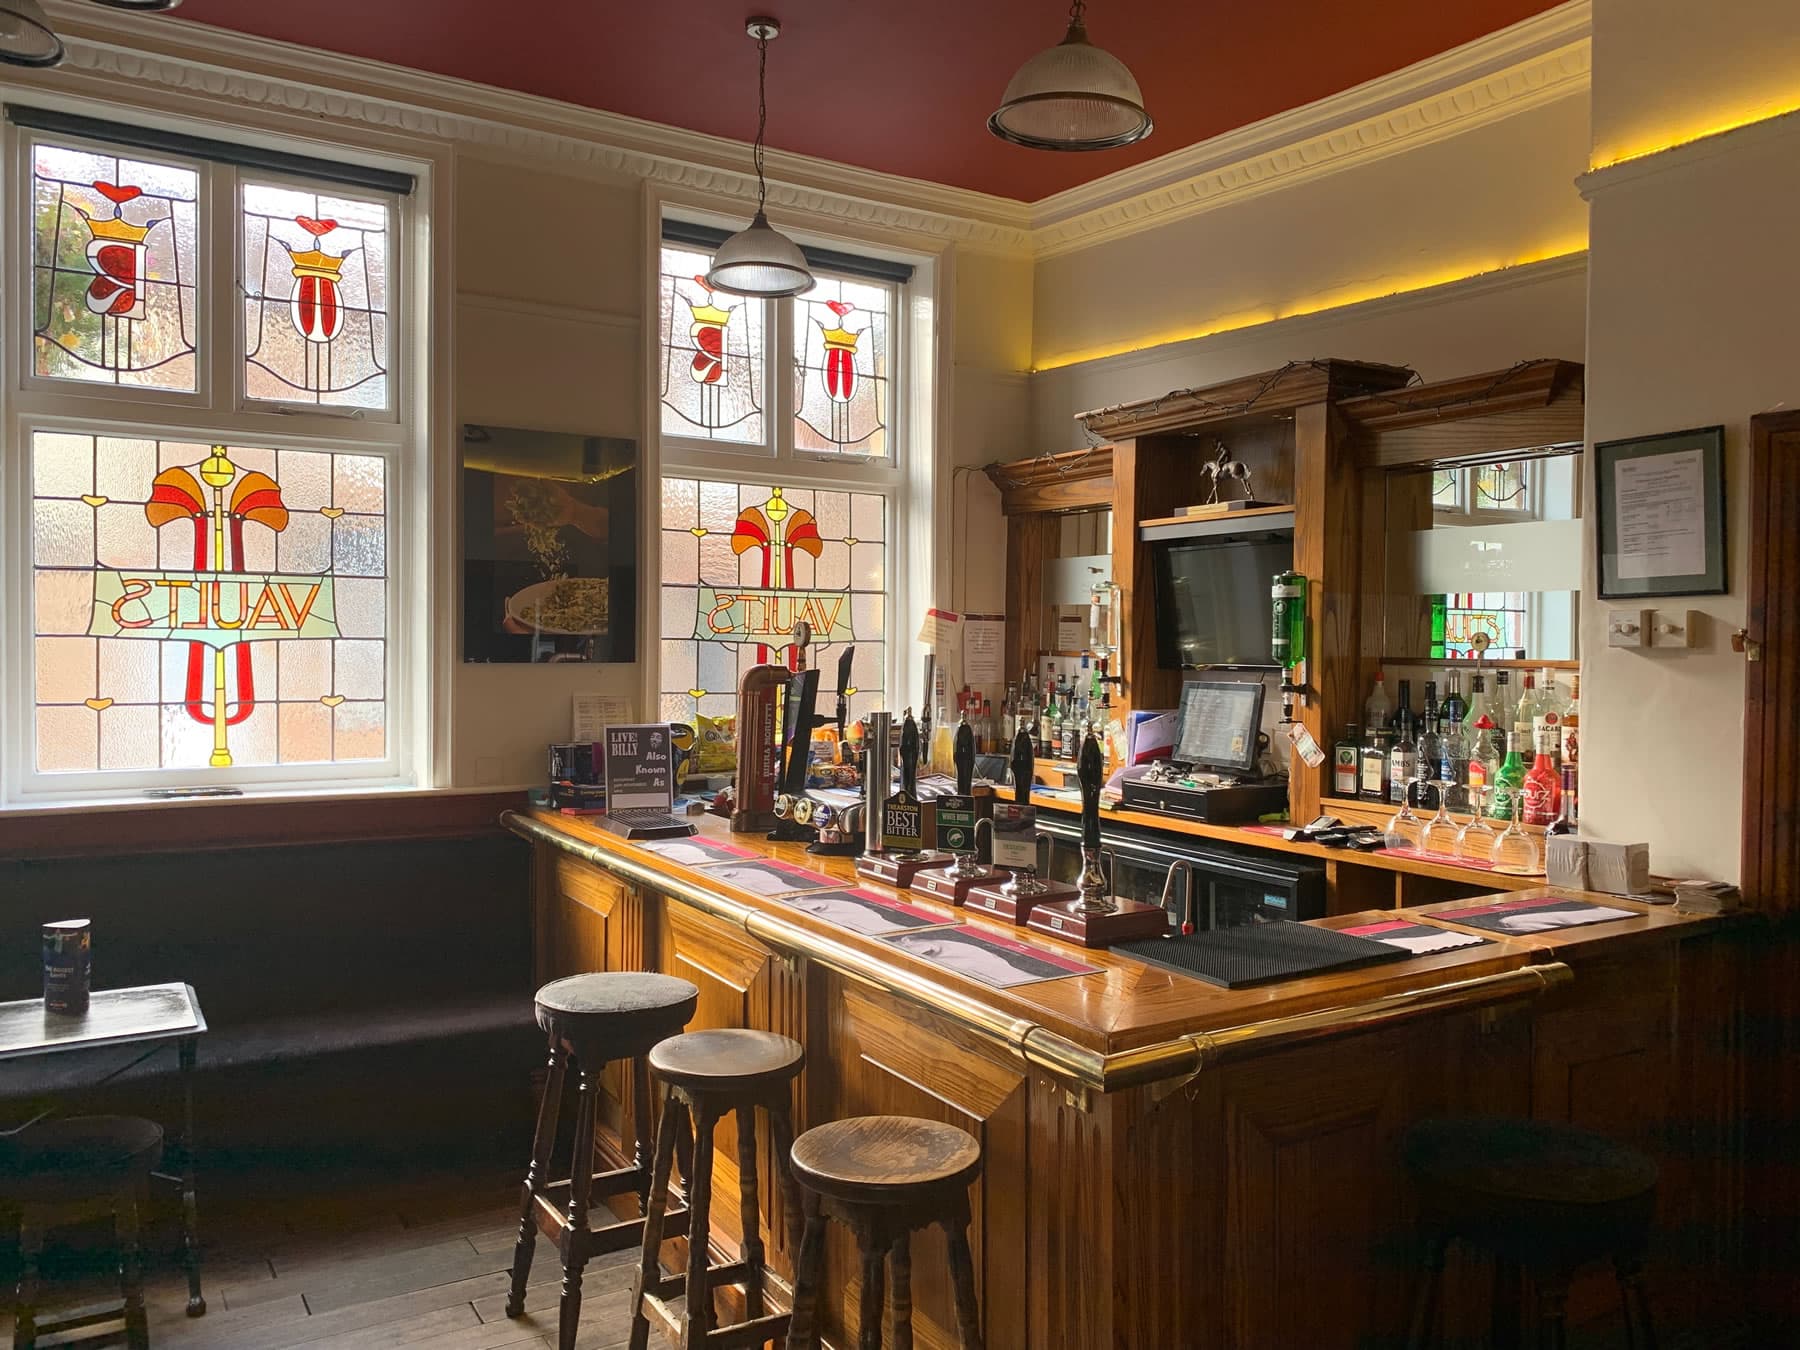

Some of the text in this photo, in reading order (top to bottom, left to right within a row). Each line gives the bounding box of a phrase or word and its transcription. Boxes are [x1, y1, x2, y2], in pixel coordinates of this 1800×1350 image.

[611, 743, 638, 756] BILLY
[646, 752, 667, 760] Also
[635, 764, 666, 774] Known
[653, 778, 665, 787] As
[887, 811, 918, 827] BEST
[886, 826, 918, 837] BITTER
